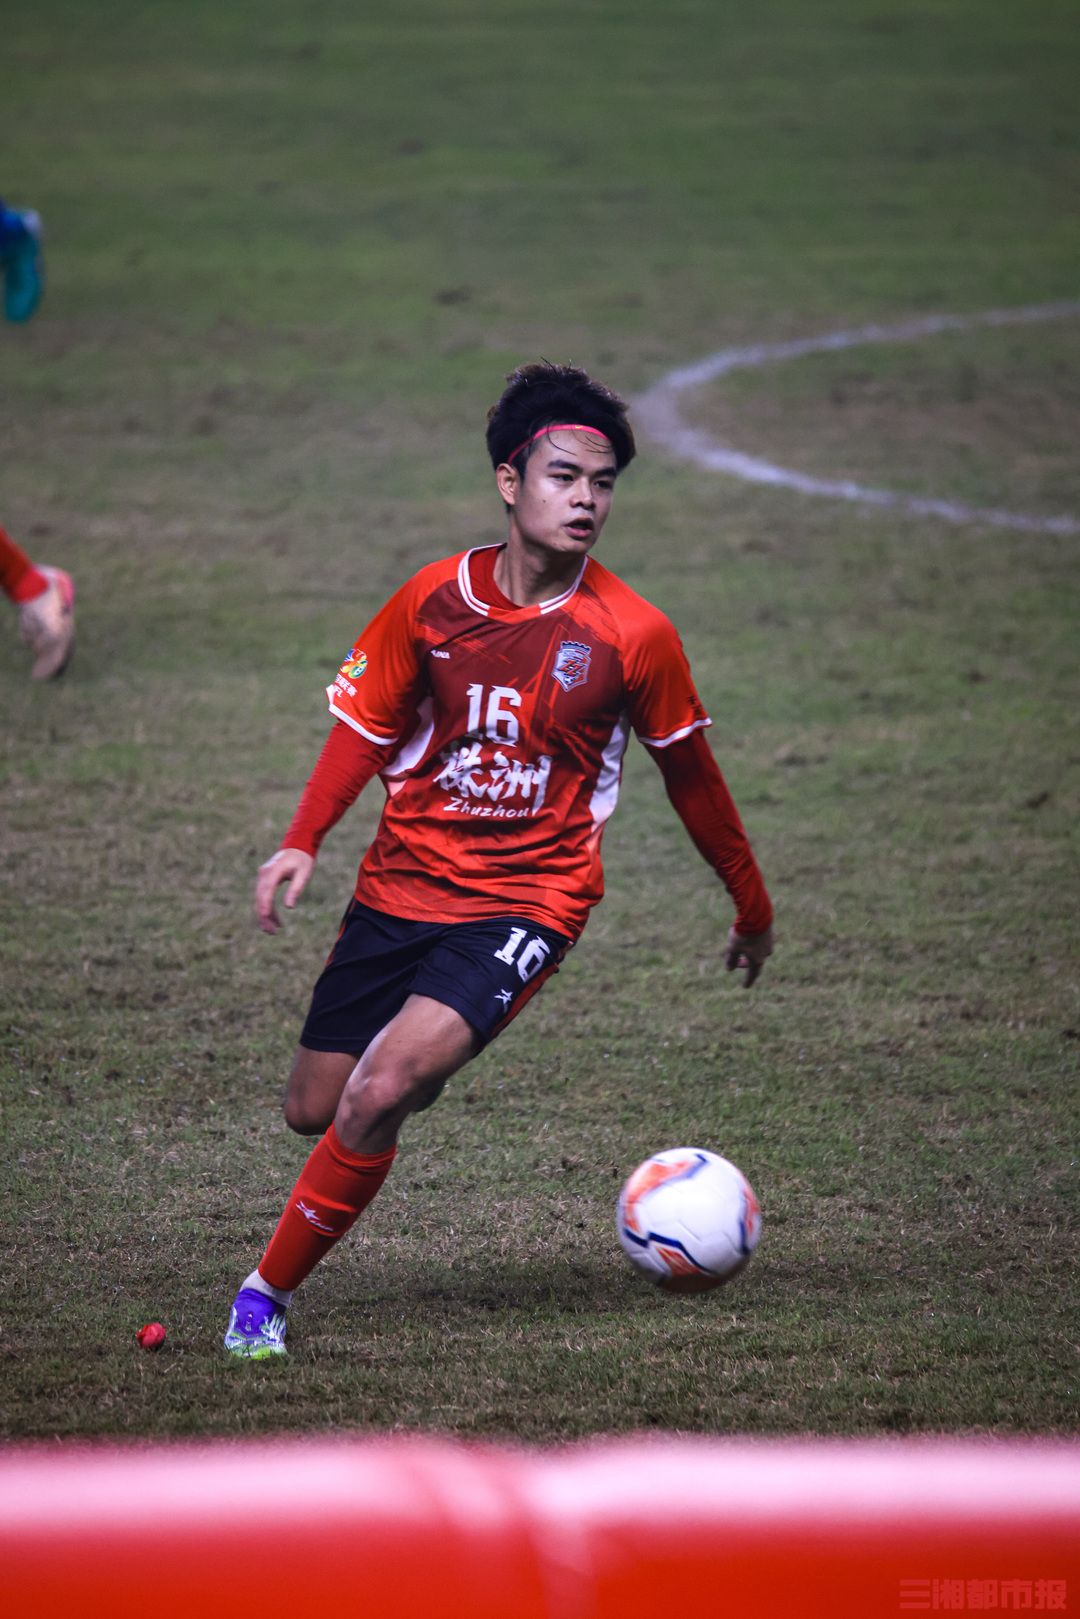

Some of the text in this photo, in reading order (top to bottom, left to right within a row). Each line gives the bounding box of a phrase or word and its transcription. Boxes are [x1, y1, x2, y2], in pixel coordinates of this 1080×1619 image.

[466, 683, 522, 748] 16
[433, 741, 553, 817] 株洲
[443, 797, 530, 818] Zhuzhou
[493, 926, 551, 984] 16
